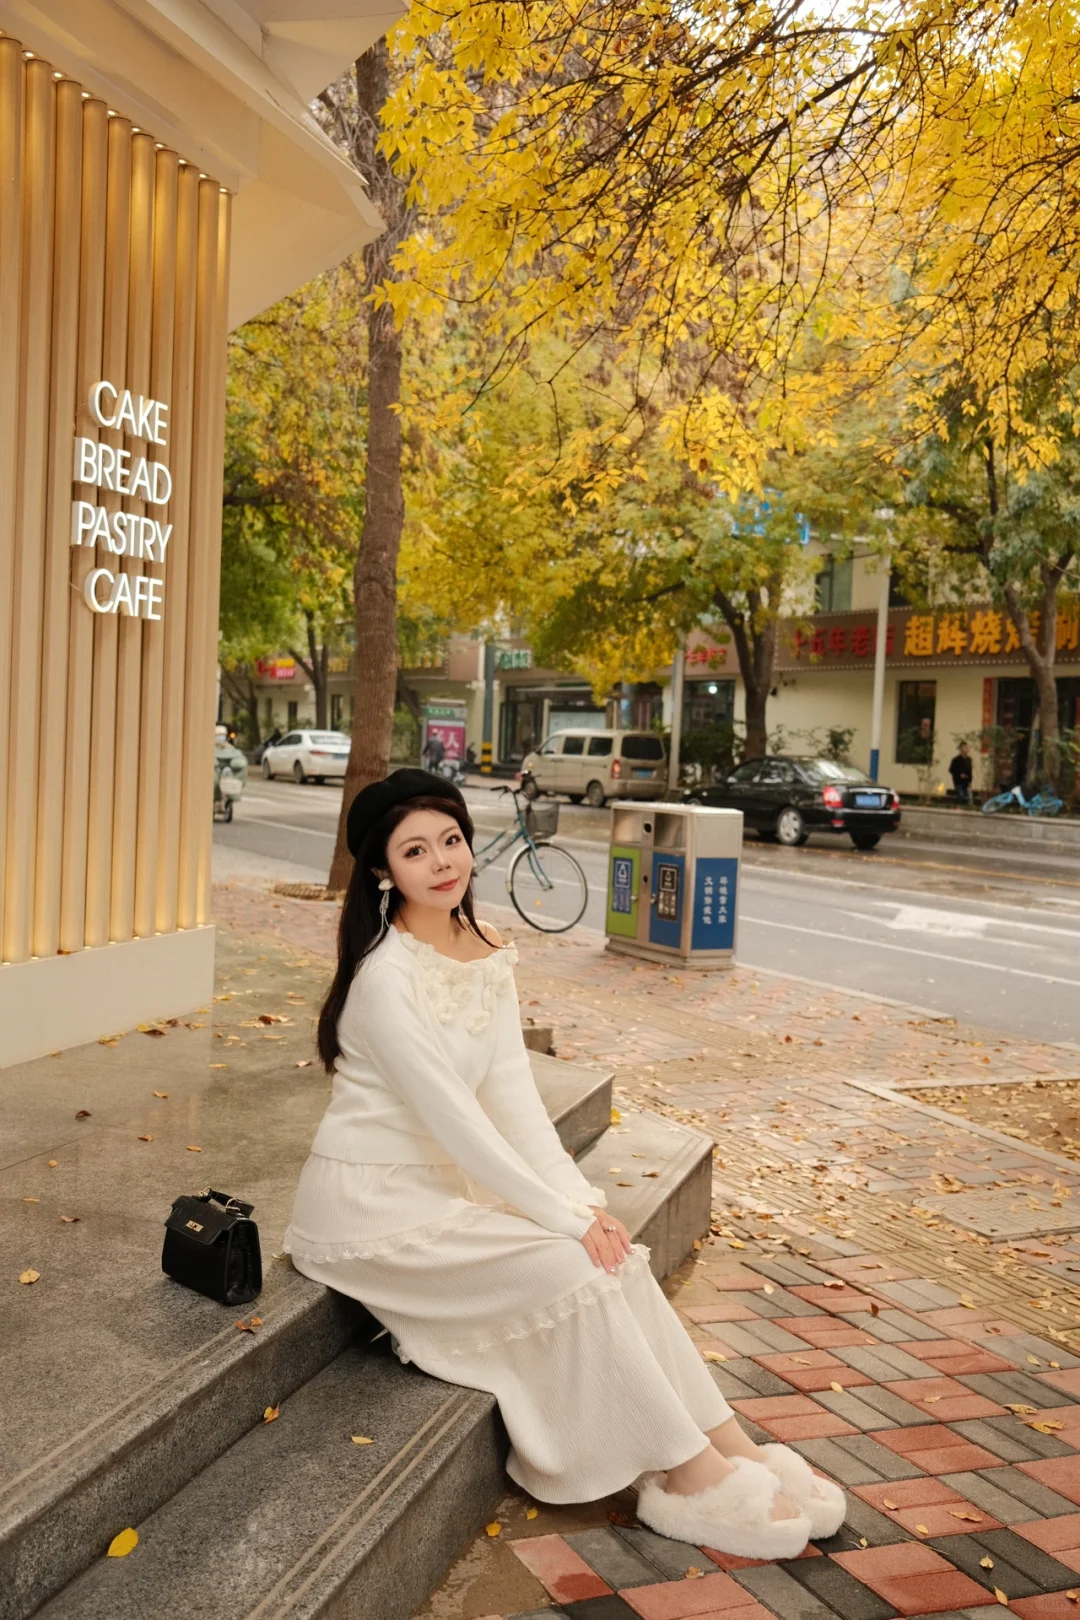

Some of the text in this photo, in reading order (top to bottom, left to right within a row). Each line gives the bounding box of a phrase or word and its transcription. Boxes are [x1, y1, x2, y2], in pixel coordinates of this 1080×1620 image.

[92, 380, 169, 446] CAKE
[78, 436, 173, 505] BREAD
[76, 500, 173, 563] PASTRY
[89, 567, 164, 621] CAFE
